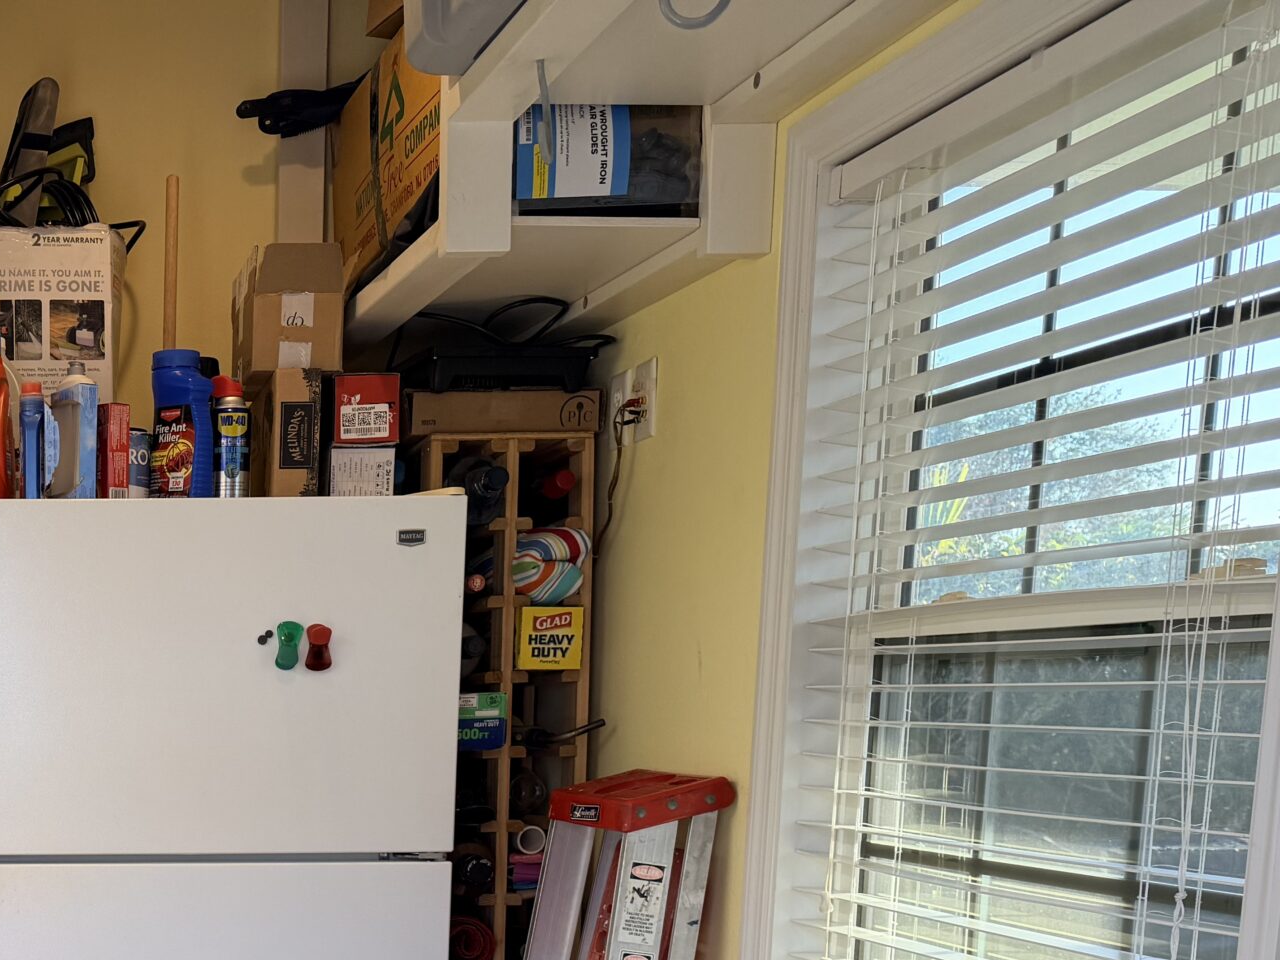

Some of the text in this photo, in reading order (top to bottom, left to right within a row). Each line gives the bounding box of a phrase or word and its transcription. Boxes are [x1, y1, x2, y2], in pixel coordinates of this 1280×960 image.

[404, 102, 440, 160] COMPAN
[588, 105, 598, 154] AIR GLIDES
[599, 109, 608, 184] WROUGHT IRON
[383, 154, 404, 197] Tree
[32, 234, 41, 246] 2
[42, 236, 61, 244] YEAR
[62, 236, 104, 244] WARRANTY
[39, 270, 48, 278] IT.
[50, 270, 70, 278] YOU
[74, 270, 91, 278] AIM
[94, 270, 104, 278] IT.
[39, 280, 52, 292] IS
[220, 415, 246, 427] WD-40
[155, 422, 187, 434] Fire Ant
[158, 433, 180, 444] Killer
[288, 408, 305, 461] MELINDA'S
[536, 615, 570, 630] GLAD
[528, 634, 575, 646] HEAVY
[531, 647, 570, 658] DUTY
